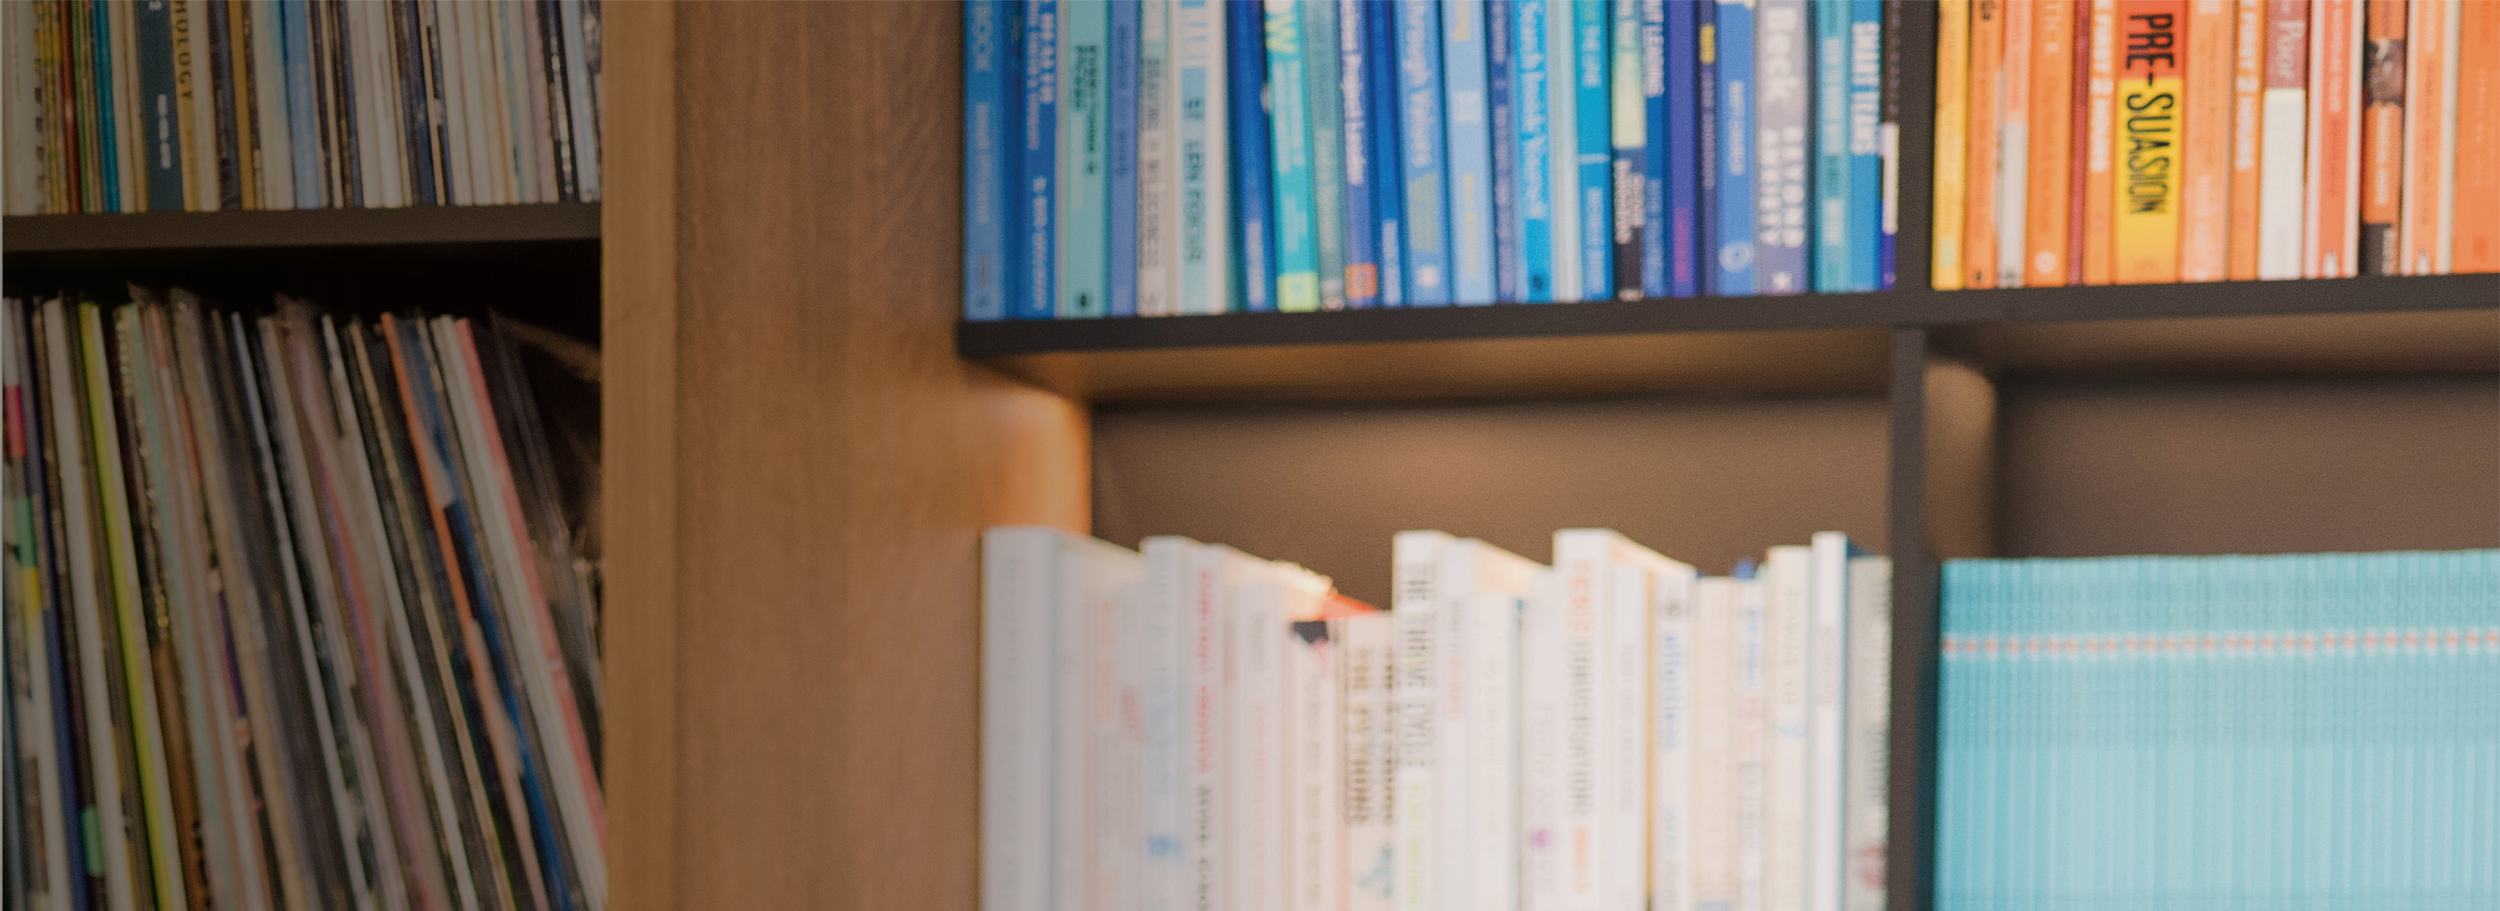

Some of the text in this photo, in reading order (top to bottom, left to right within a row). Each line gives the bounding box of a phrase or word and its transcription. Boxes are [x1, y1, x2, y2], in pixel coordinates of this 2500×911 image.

[971, 5, 993, 72] BOOK
[1764, 6, 1800, 103] Beck
[2092, 14, 2112, 73] FIRST
[2238, 11, 2257, 71] FIRST
[2277, 19, 2306, 80] Poor
[1850, 22, 1880, 156] SMART TEAMS
[2090, 78, 2113, 95] 2
[2125, 13, 2176, 216] PRE-SUASION
[2236, 75, 2259, 92] 2
[1409, 89, 1433, 170] Values
[2236, 96, 2255, 171] HOURS
[1759, 128, 1782, 247] ANXIETY
[1783, 126, 1805, 249] BEYOND
[1404, 563, 1435, 602] THE
[1403, 611, 1434, 689] THRIVE
